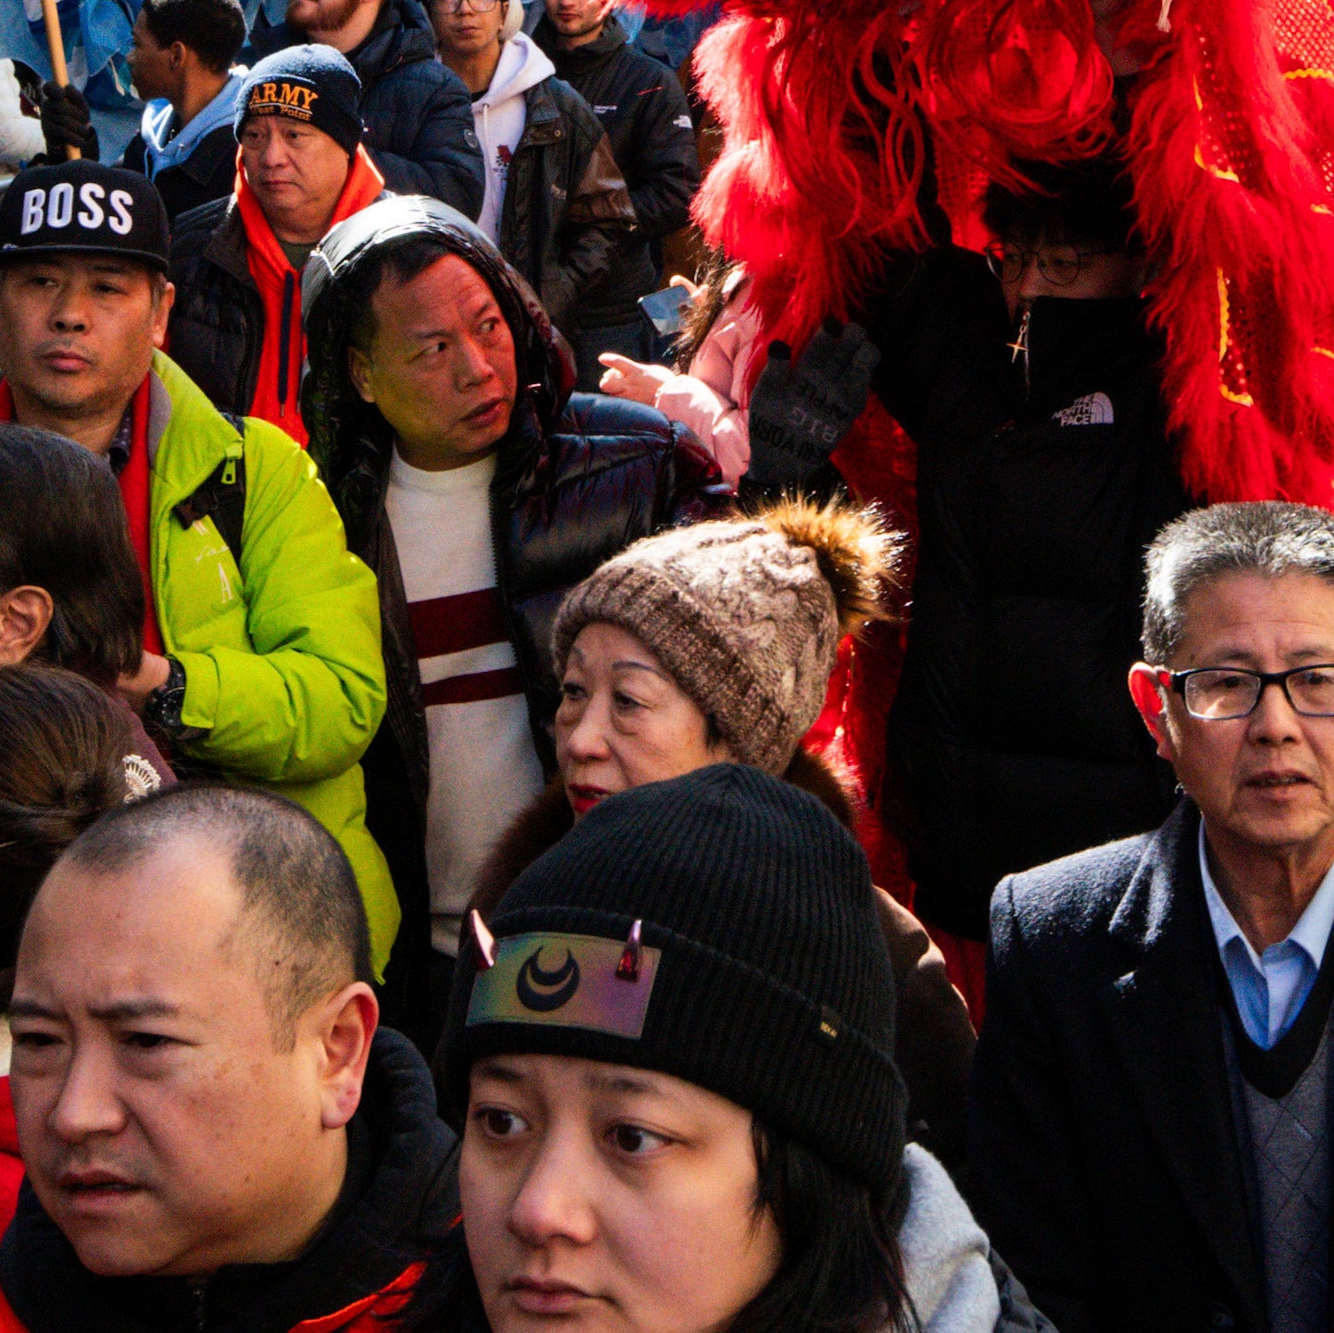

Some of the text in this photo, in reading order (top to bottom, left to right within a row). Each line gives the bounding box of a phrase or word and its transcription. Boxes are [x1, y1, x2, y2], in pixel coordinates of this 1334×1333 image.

[249, 83, 319, 110] ARMY
[20, 182, 134, 235] BOSS
[1060, 413, 1091, 427] FACE
